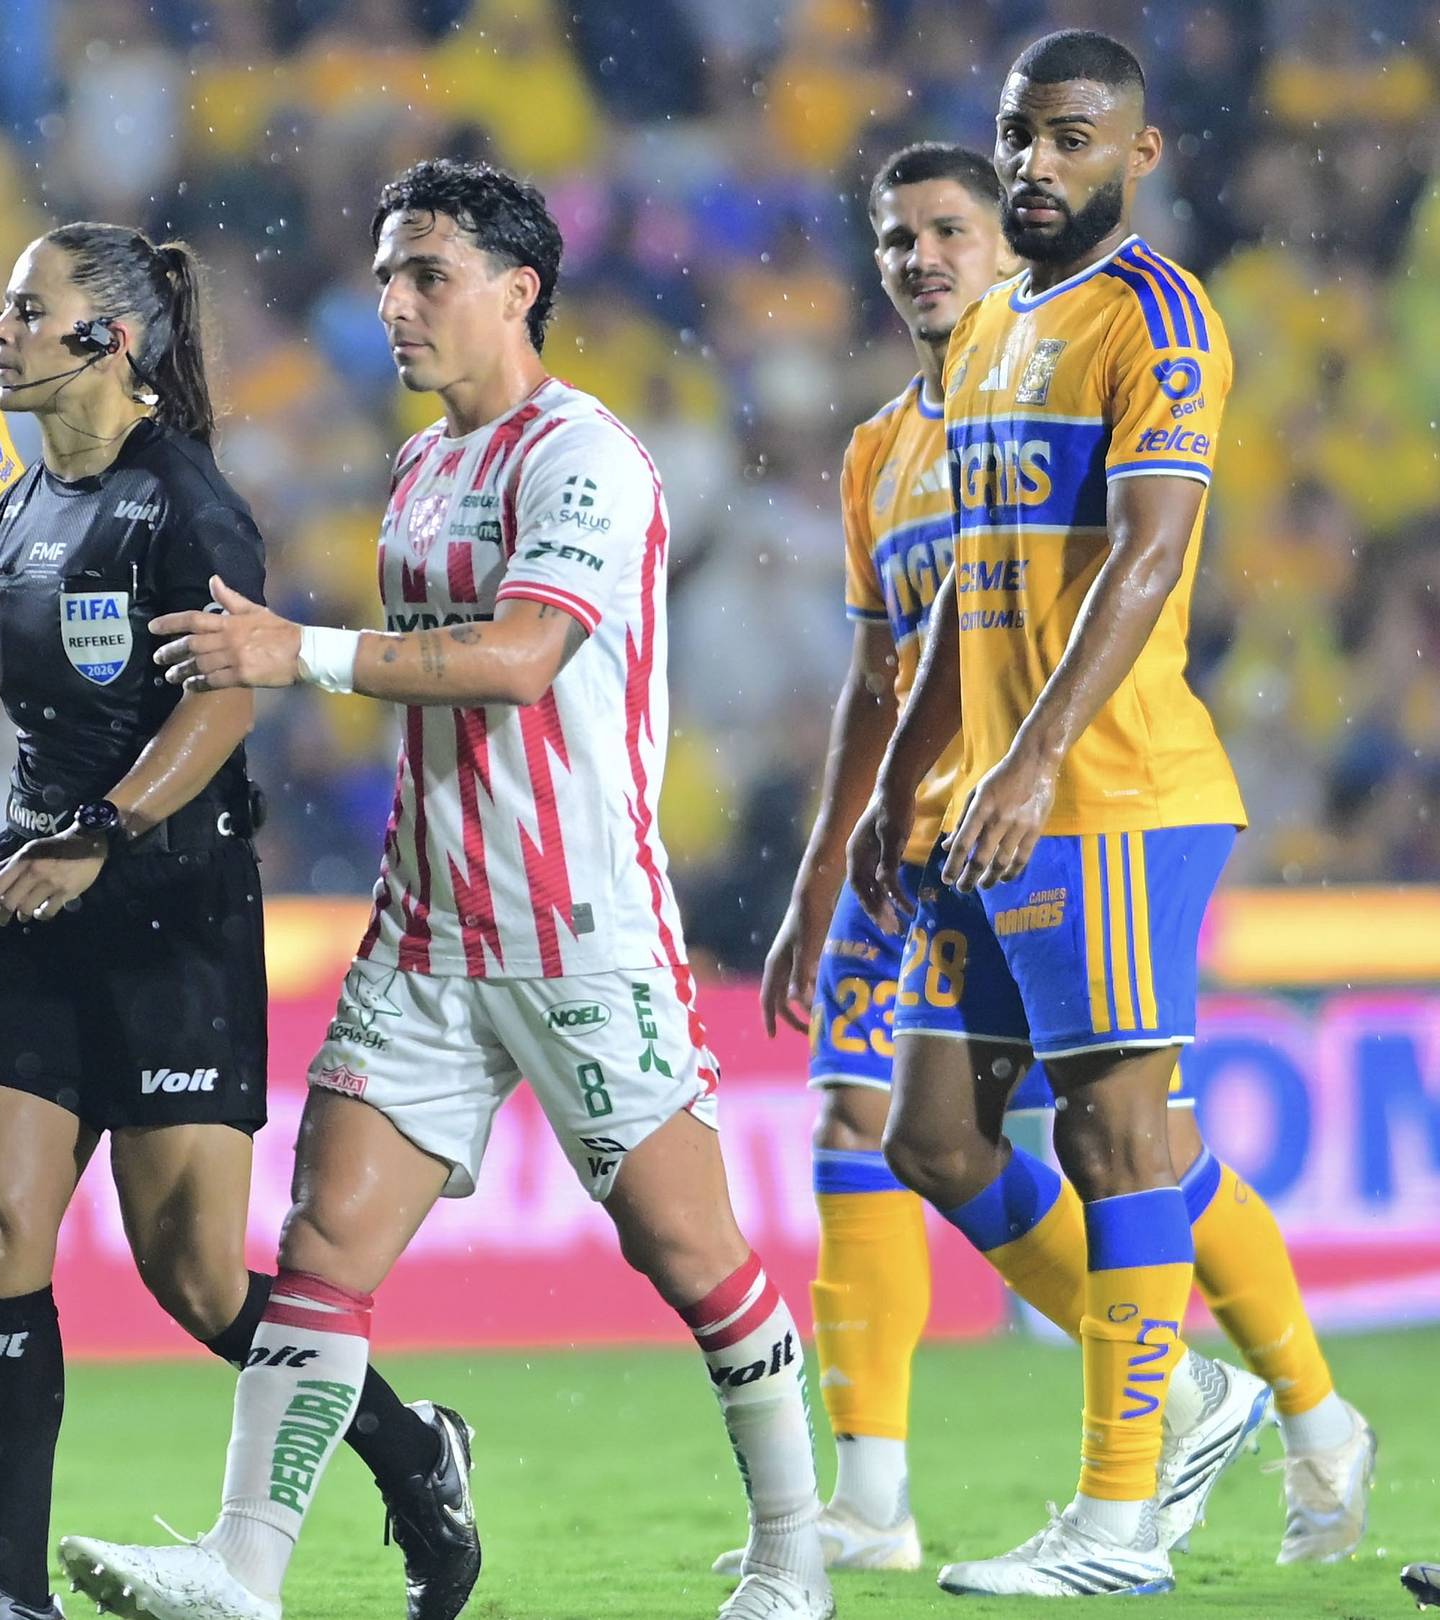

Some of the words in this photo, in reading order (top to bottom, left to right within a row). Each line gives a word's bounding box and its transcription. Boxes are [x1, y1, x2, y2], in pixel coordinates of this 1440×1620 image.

[114, 500, 161, 522] Voit
[29, 541, 67, 561] FMF
[557, 544, 604, 572] ETN
[66, 598, 120, 621] FIFA
[68, 633, 126, 649] REFEREE
[87, 665, 116, 677] 2026
[896, 927, 968, 1008] 28
[548, 1004, 606, 1029] NOEL
[631, 982, 659, 1040] ETN
[831, 976, 897, 1057] 23
[141, 1067, 219, 1094] Voit
[576, 1061, 614, 1119] 8
[248, 1345, 320, 1369] oit
[269, 1379, 357, 1517] PERDURA
